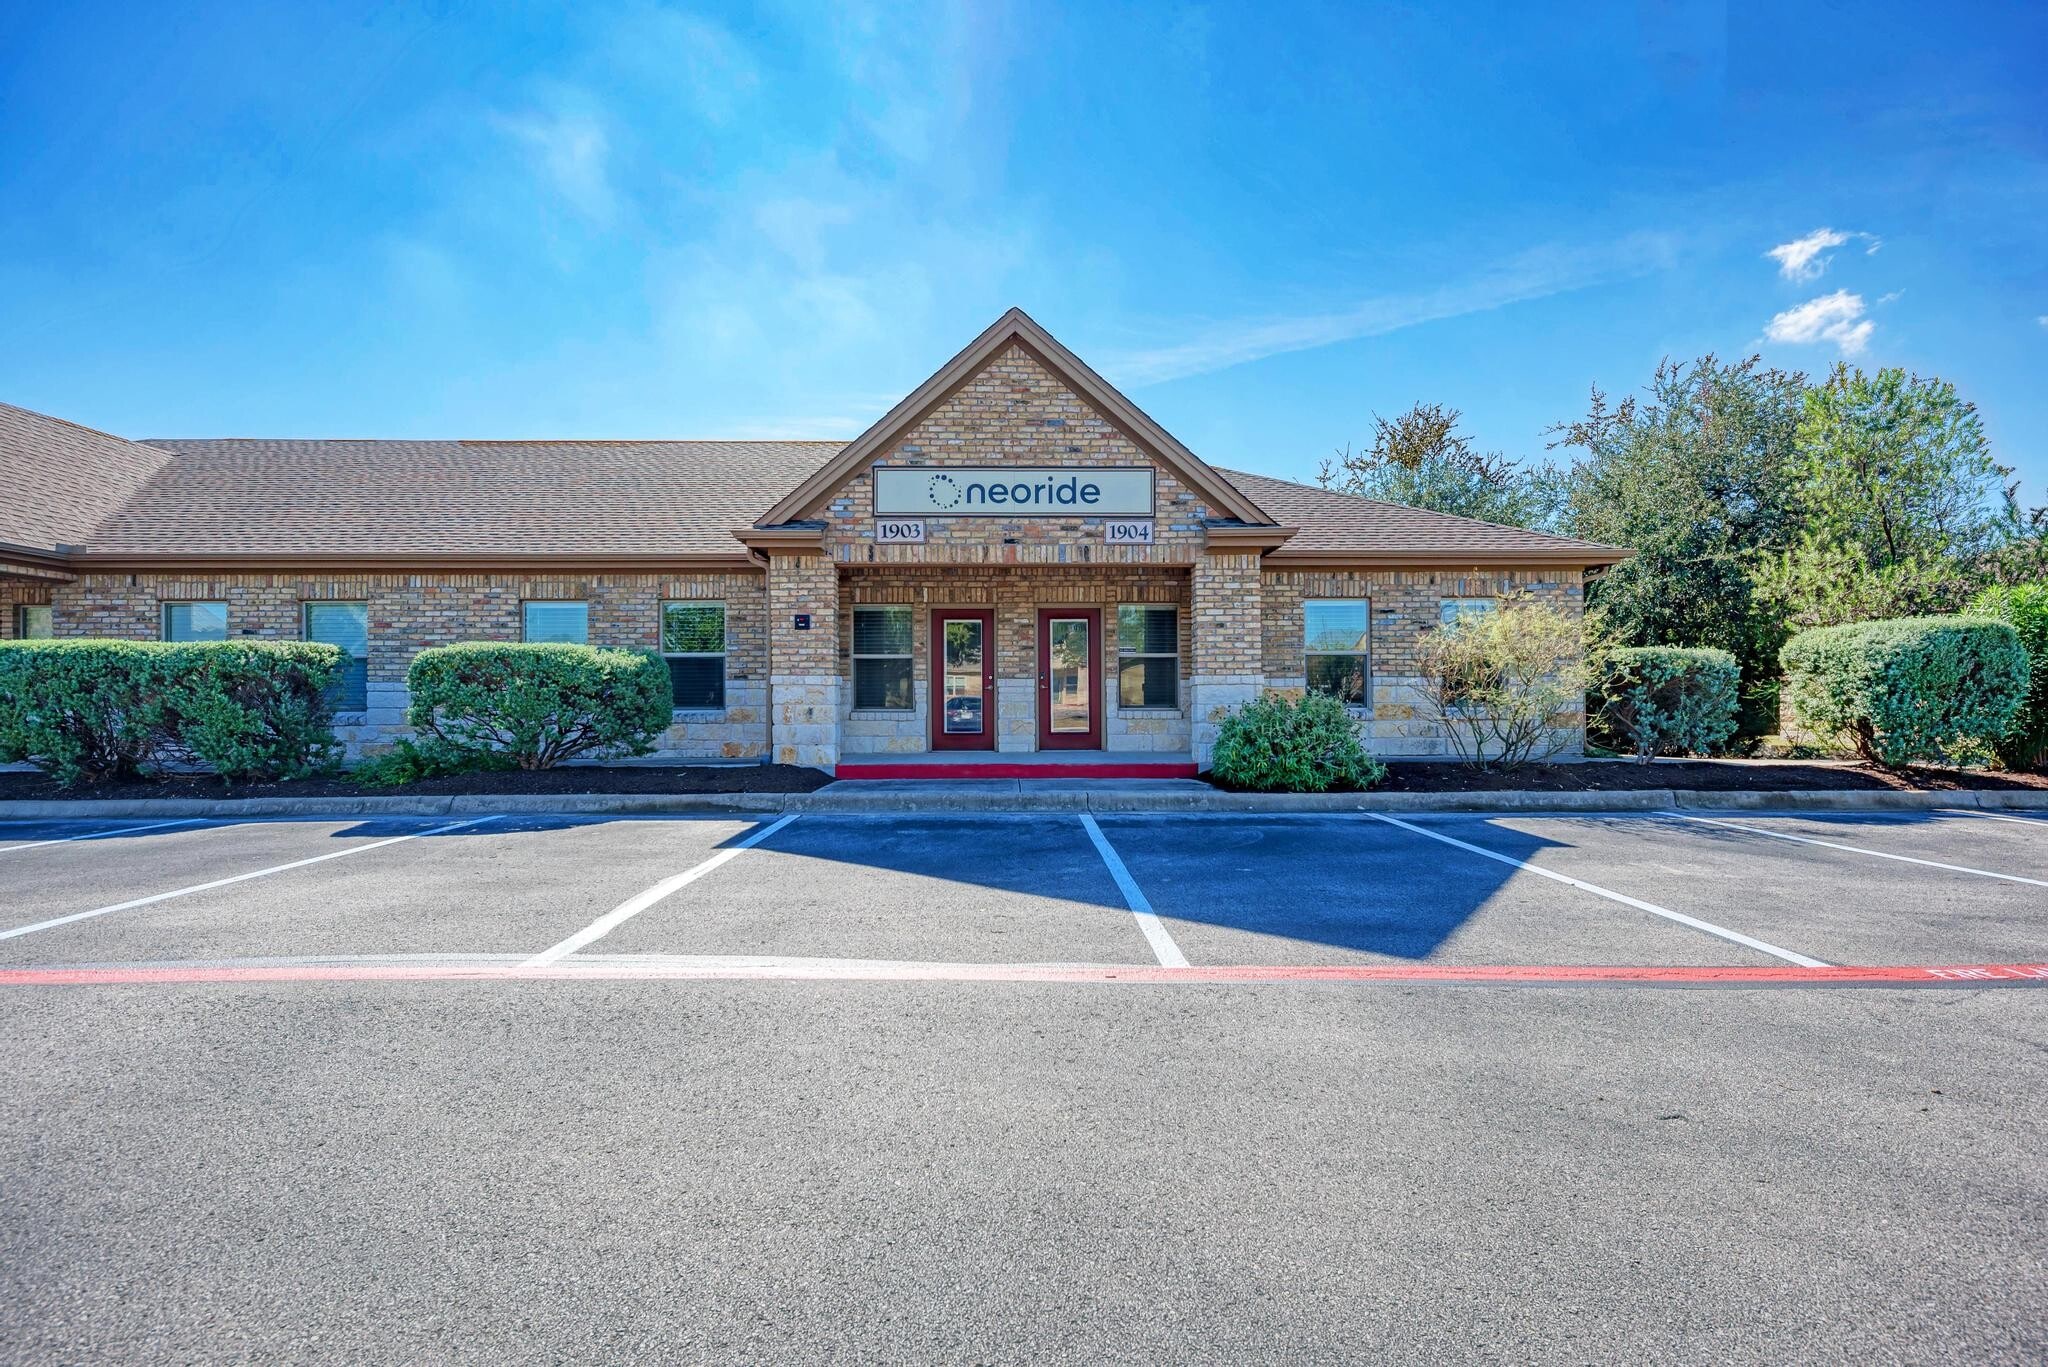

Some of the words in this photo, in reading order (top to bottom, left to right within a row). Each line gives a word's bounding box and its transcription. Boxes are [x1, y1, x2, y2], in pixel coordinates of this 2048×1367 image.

[966, 476, 1101, 504] neoride
[880, 523, 921, 539] 1903
[1109, 524, 1150, 541] 1904
